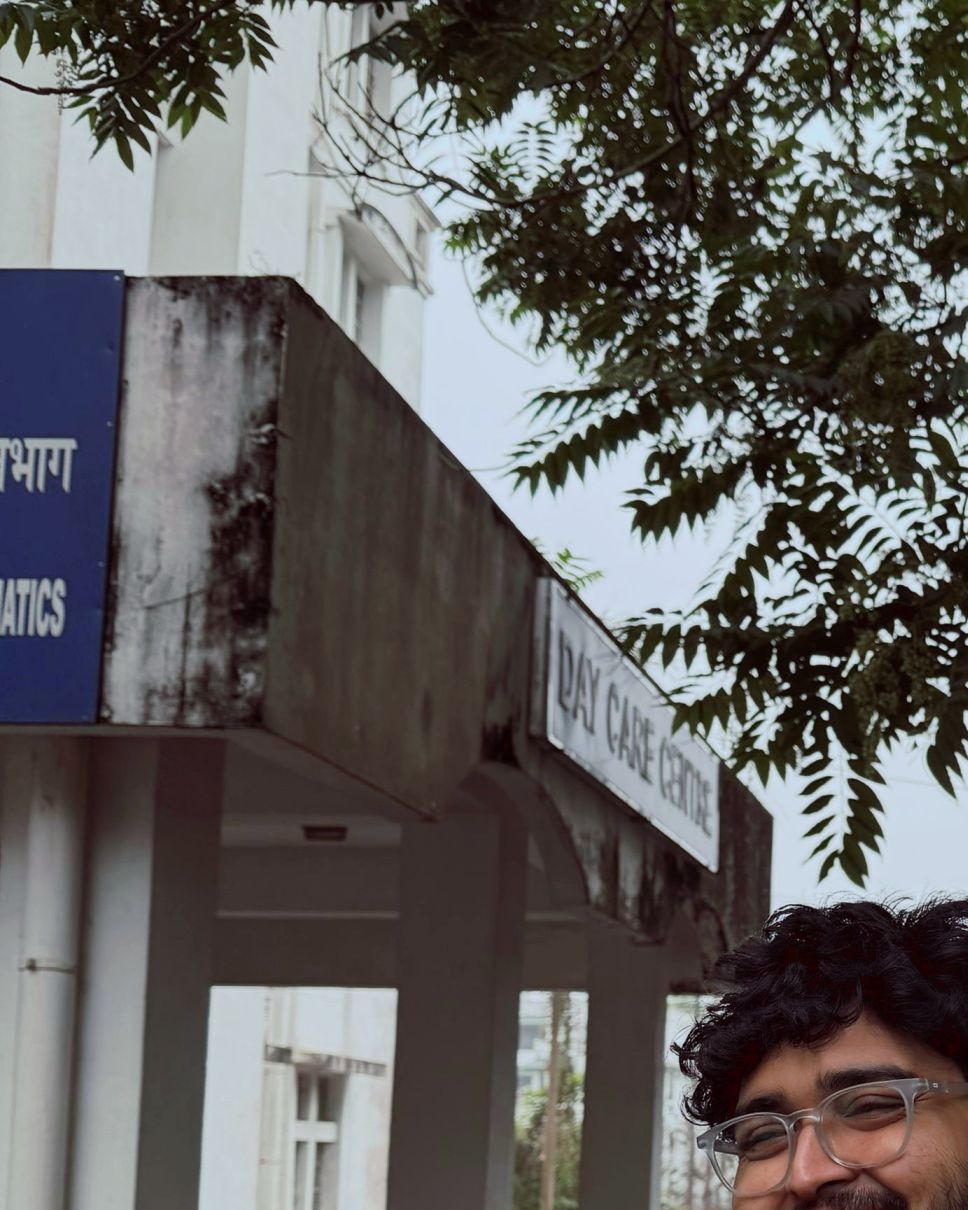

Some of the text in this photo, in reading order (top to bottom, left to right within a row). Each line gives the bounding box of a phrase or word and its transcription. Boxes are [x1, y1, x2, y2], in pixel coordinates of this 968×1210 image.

[557, 630, 714, 838] DAY CARE CENTRE
